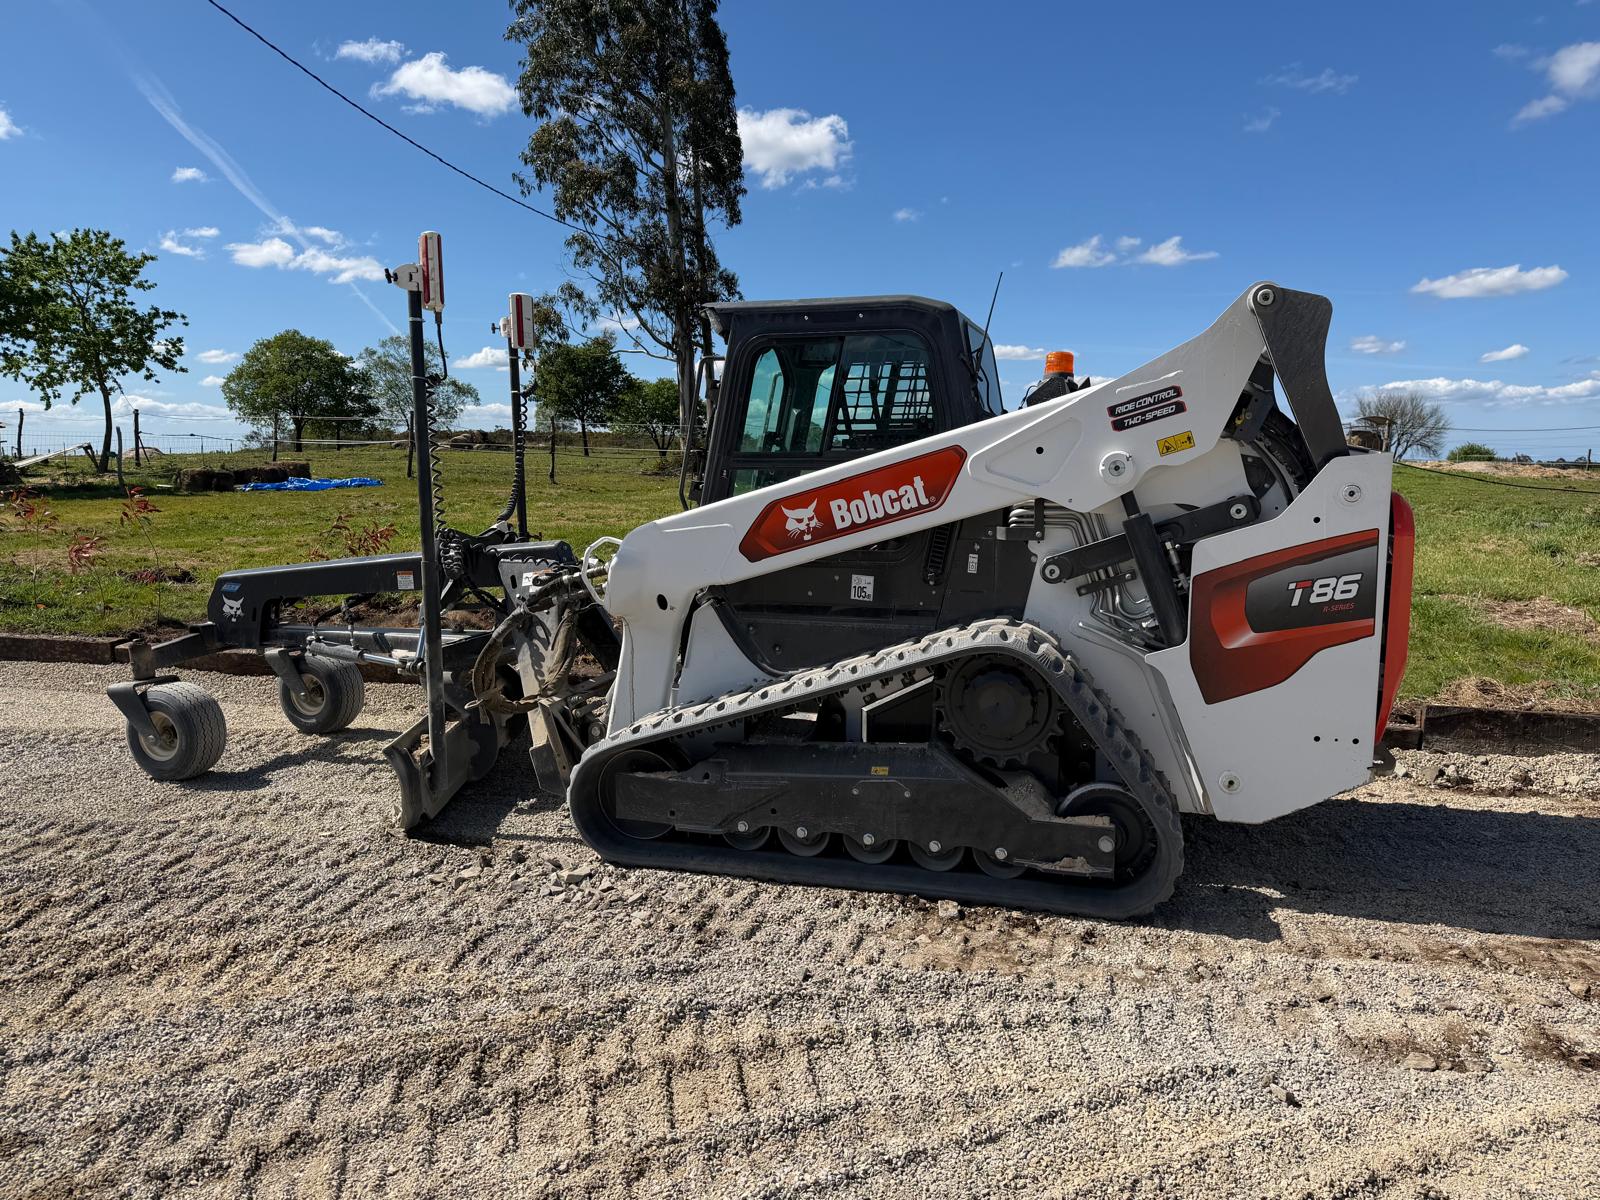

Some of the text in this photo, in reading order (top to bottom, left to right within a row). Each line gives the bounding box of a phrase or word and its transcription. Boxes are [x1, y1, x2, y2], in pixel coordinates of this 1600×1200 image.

[1115, 389, 1177, 415] RIDE CONTROL
[1123, 405, 1176, 427] TWO-SPEED
[829, 475, 929, 530] Bobcat
[853, 585, 867, 599] 105
[1288, 573, 1362, 607] T86
[1322, 602, 1356, 613] R-SERIES
